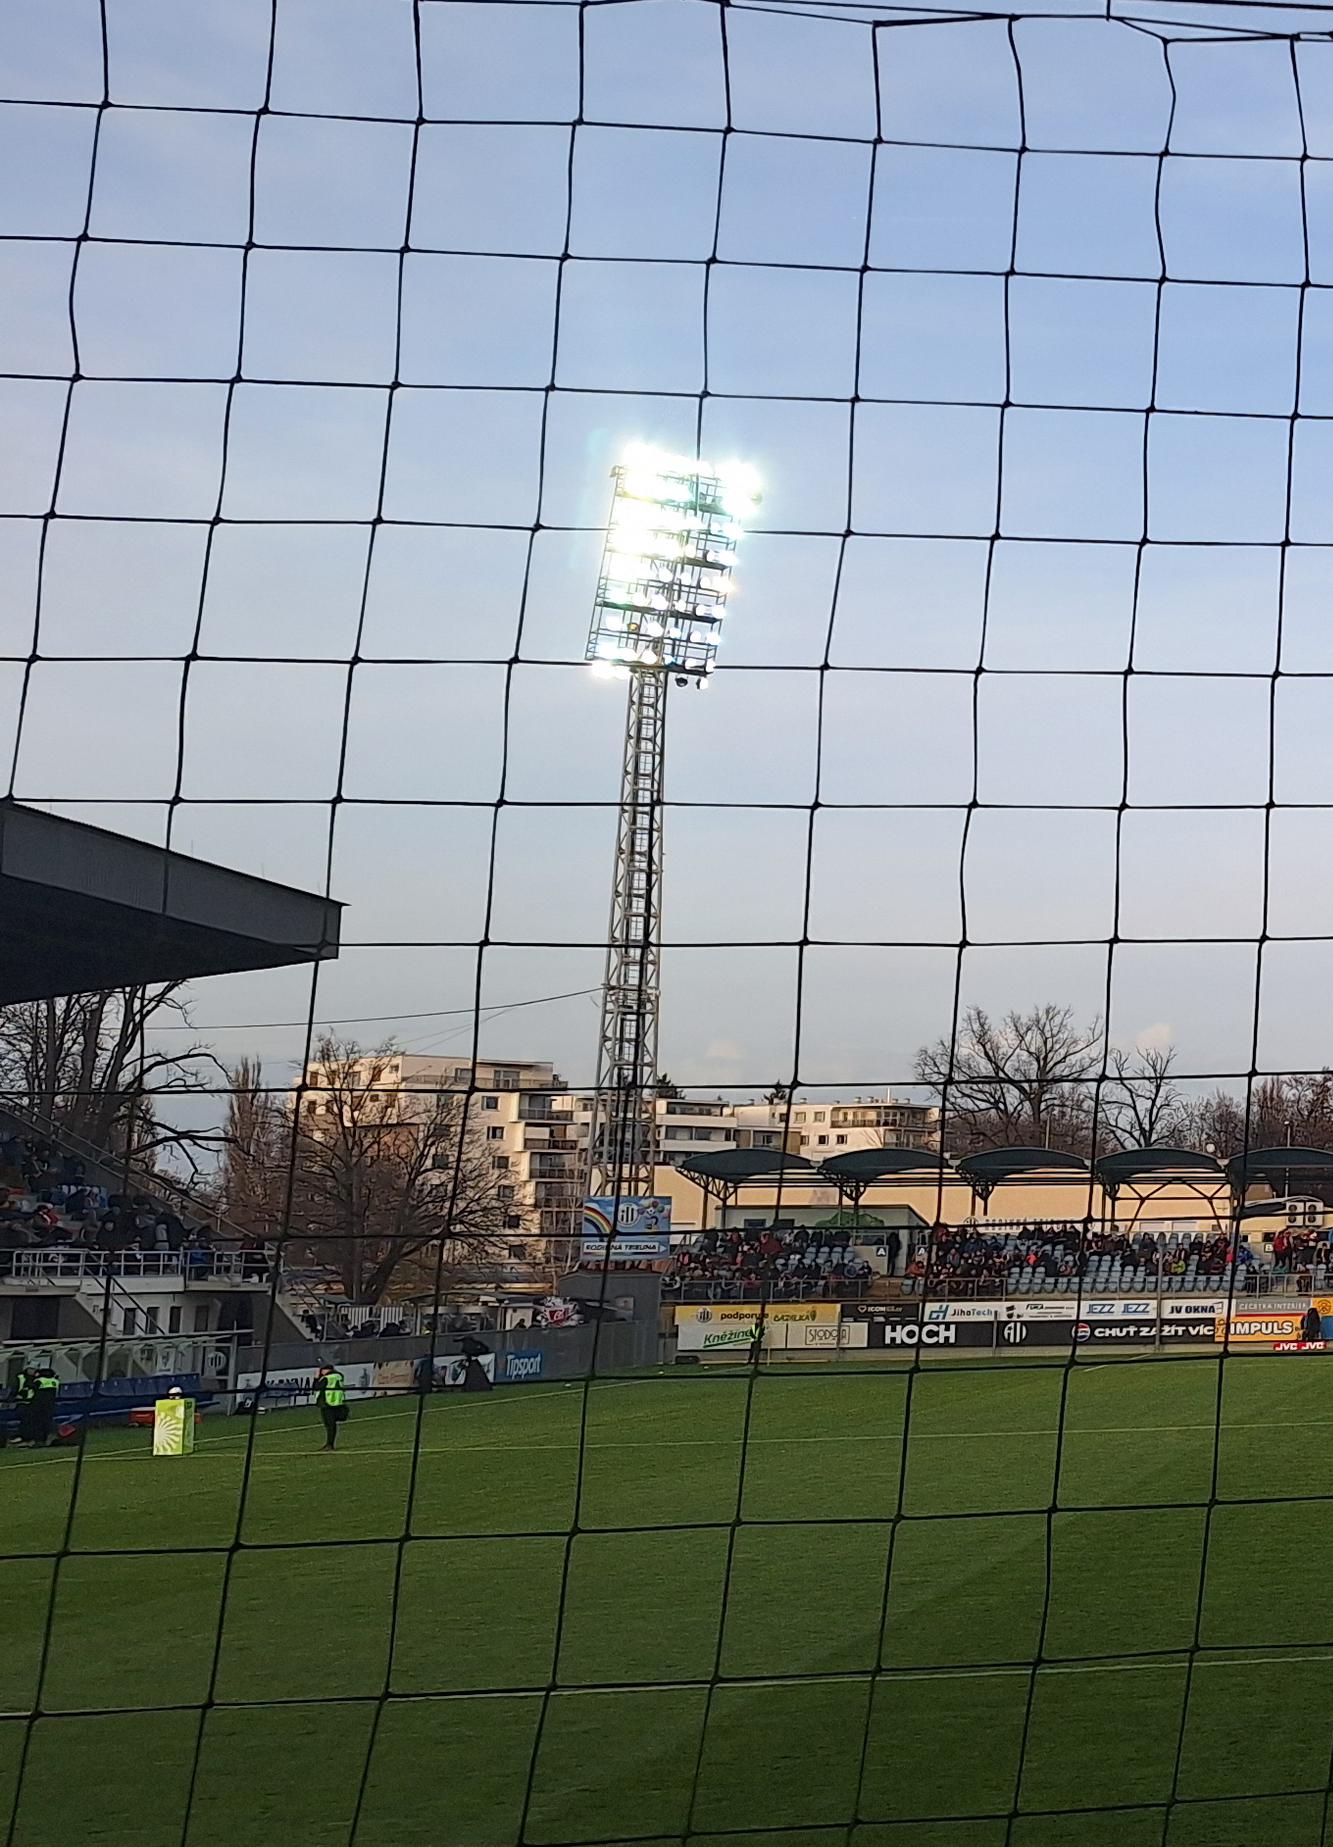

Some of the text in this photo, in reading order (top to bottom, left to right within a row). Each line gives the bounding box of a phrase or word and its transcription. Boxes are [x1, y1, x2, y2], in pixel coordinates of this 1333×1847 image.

[877, 1248, 886, 1256] A
[951, 1308, 993, 1317] JihoTech
[1169, 1305, 1216, 1314] JV OKNA
[720, 1311, 769, 1321] podporue
[1094, 1325, 1138, 1337] CHUŤ
[1187, 1324, 1215, 1335] VÍC
[1229, 1321, 1293, 1335] IMPULS
[808, 1327, 847, 1343] STODOA
[885, 1323, 956, 1345] HOCH
[1274, 1342, 1298, 1351] JVC
[1302, 1341, 1325, 1350] JVC
[505, 1354, 542, 1380] Tipsport
